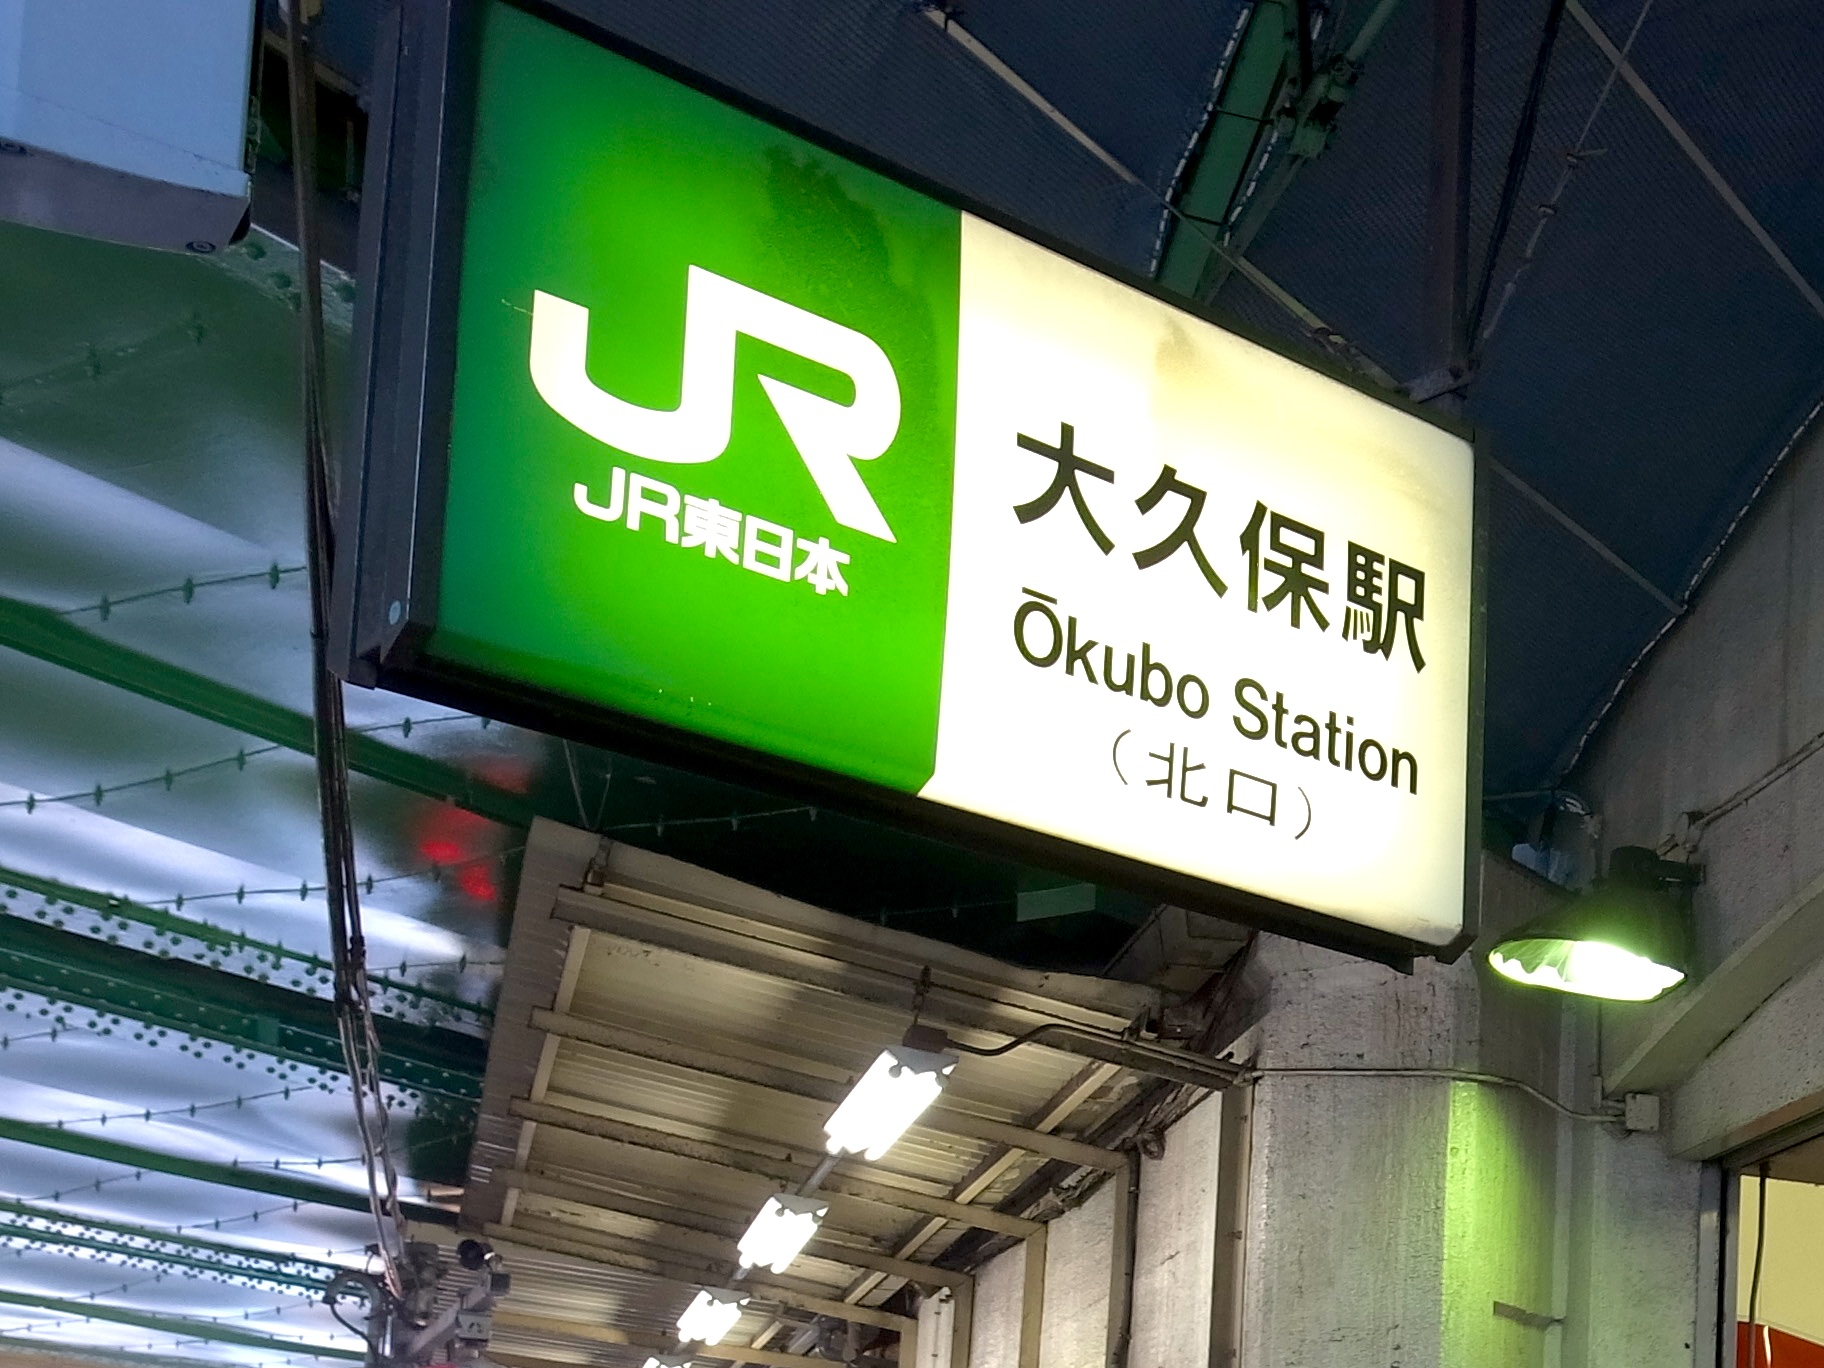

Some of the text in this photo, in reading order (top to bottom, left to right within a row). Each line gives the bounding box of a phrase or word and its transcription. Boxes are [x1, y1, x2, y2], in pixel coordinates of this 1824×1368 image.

[529, 264, 901, 543] JR
[573, 467, 850, 597] JR東日本
[1012, 422, 1428, 673] 大久保駅
[1012, 587, 1420, 795] Ōkubo Station
